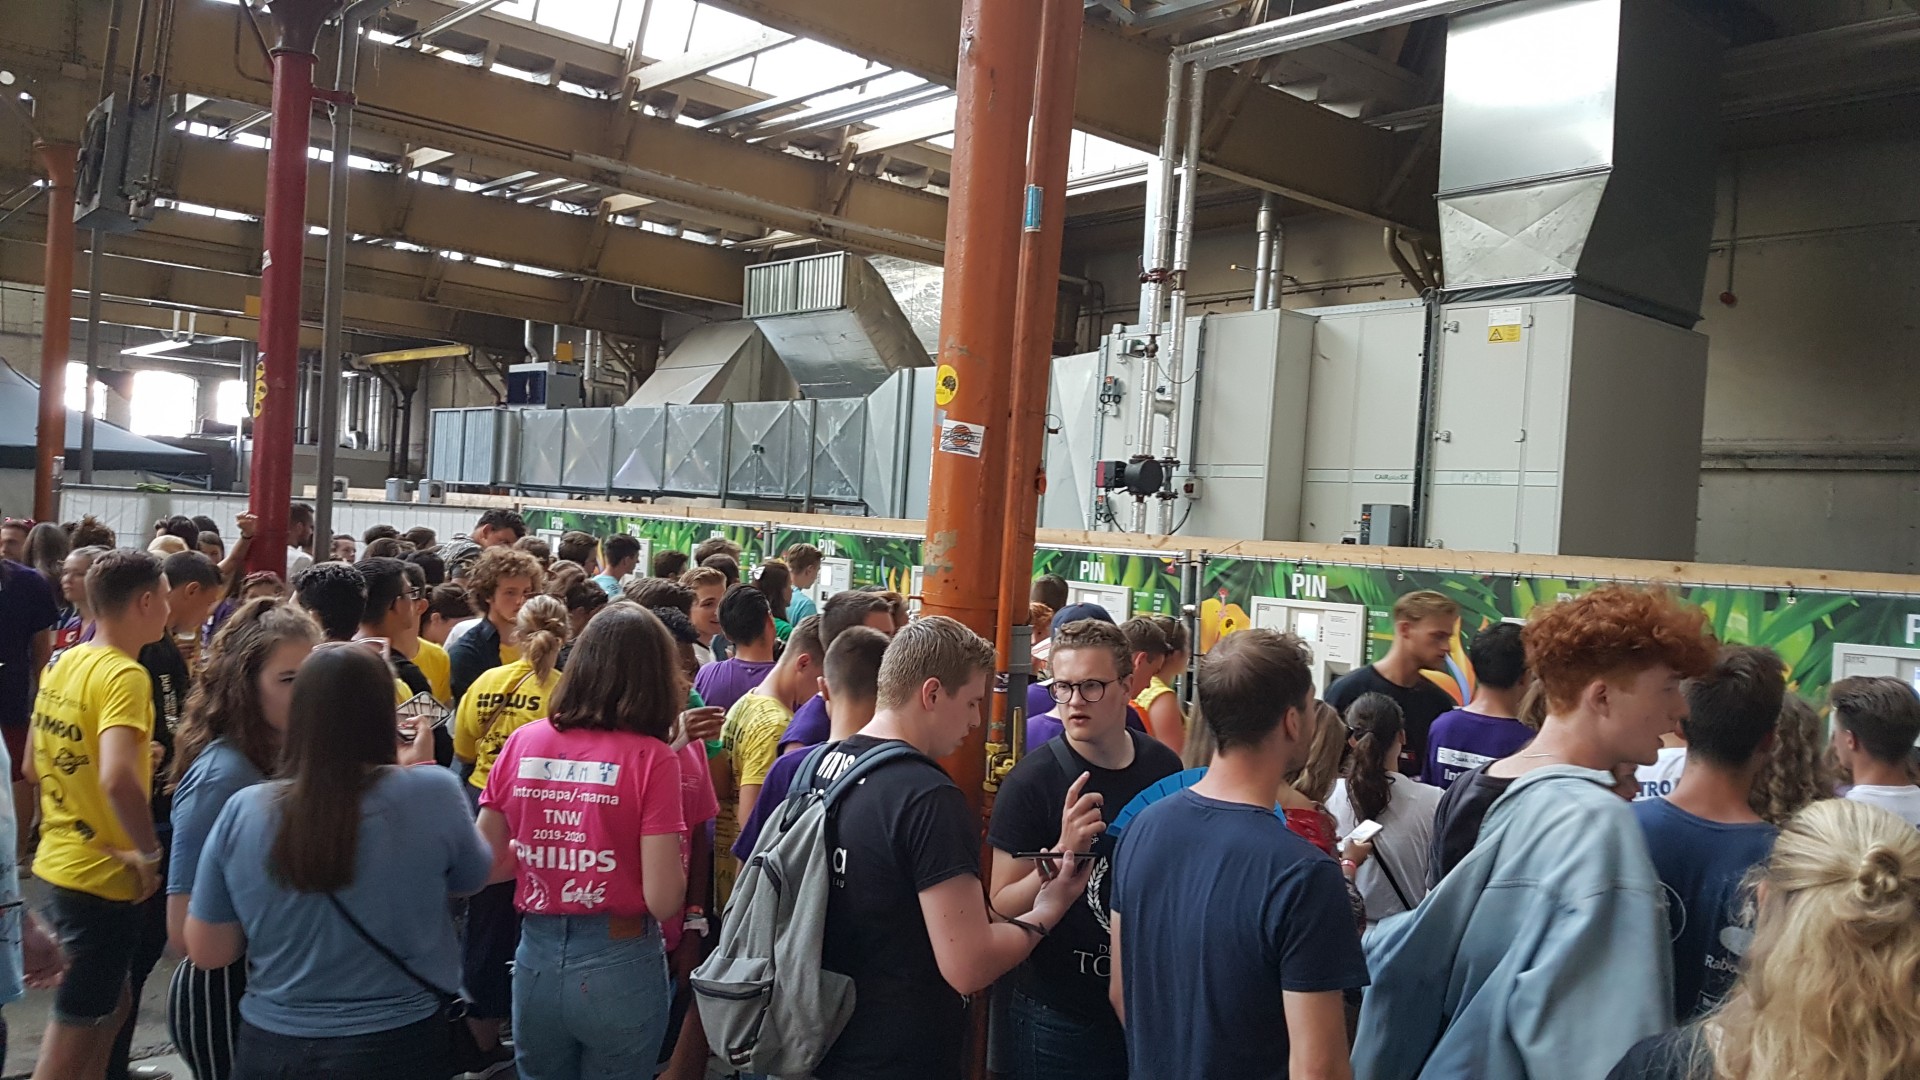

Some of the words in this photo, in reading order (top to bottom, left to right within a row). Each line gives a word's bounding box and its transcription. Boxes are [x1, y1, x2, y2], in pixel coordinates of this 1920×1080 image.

[818, 539, 836, 556] PIN
[1080, 560, 1105, 581] PIN
[1291, 573, 1327, 598] PIN
[543, 809, 583, 826] TNW
[533, 829, 586, 843] 2019-2020
[515, 842, 617, 873] PHILIPS
